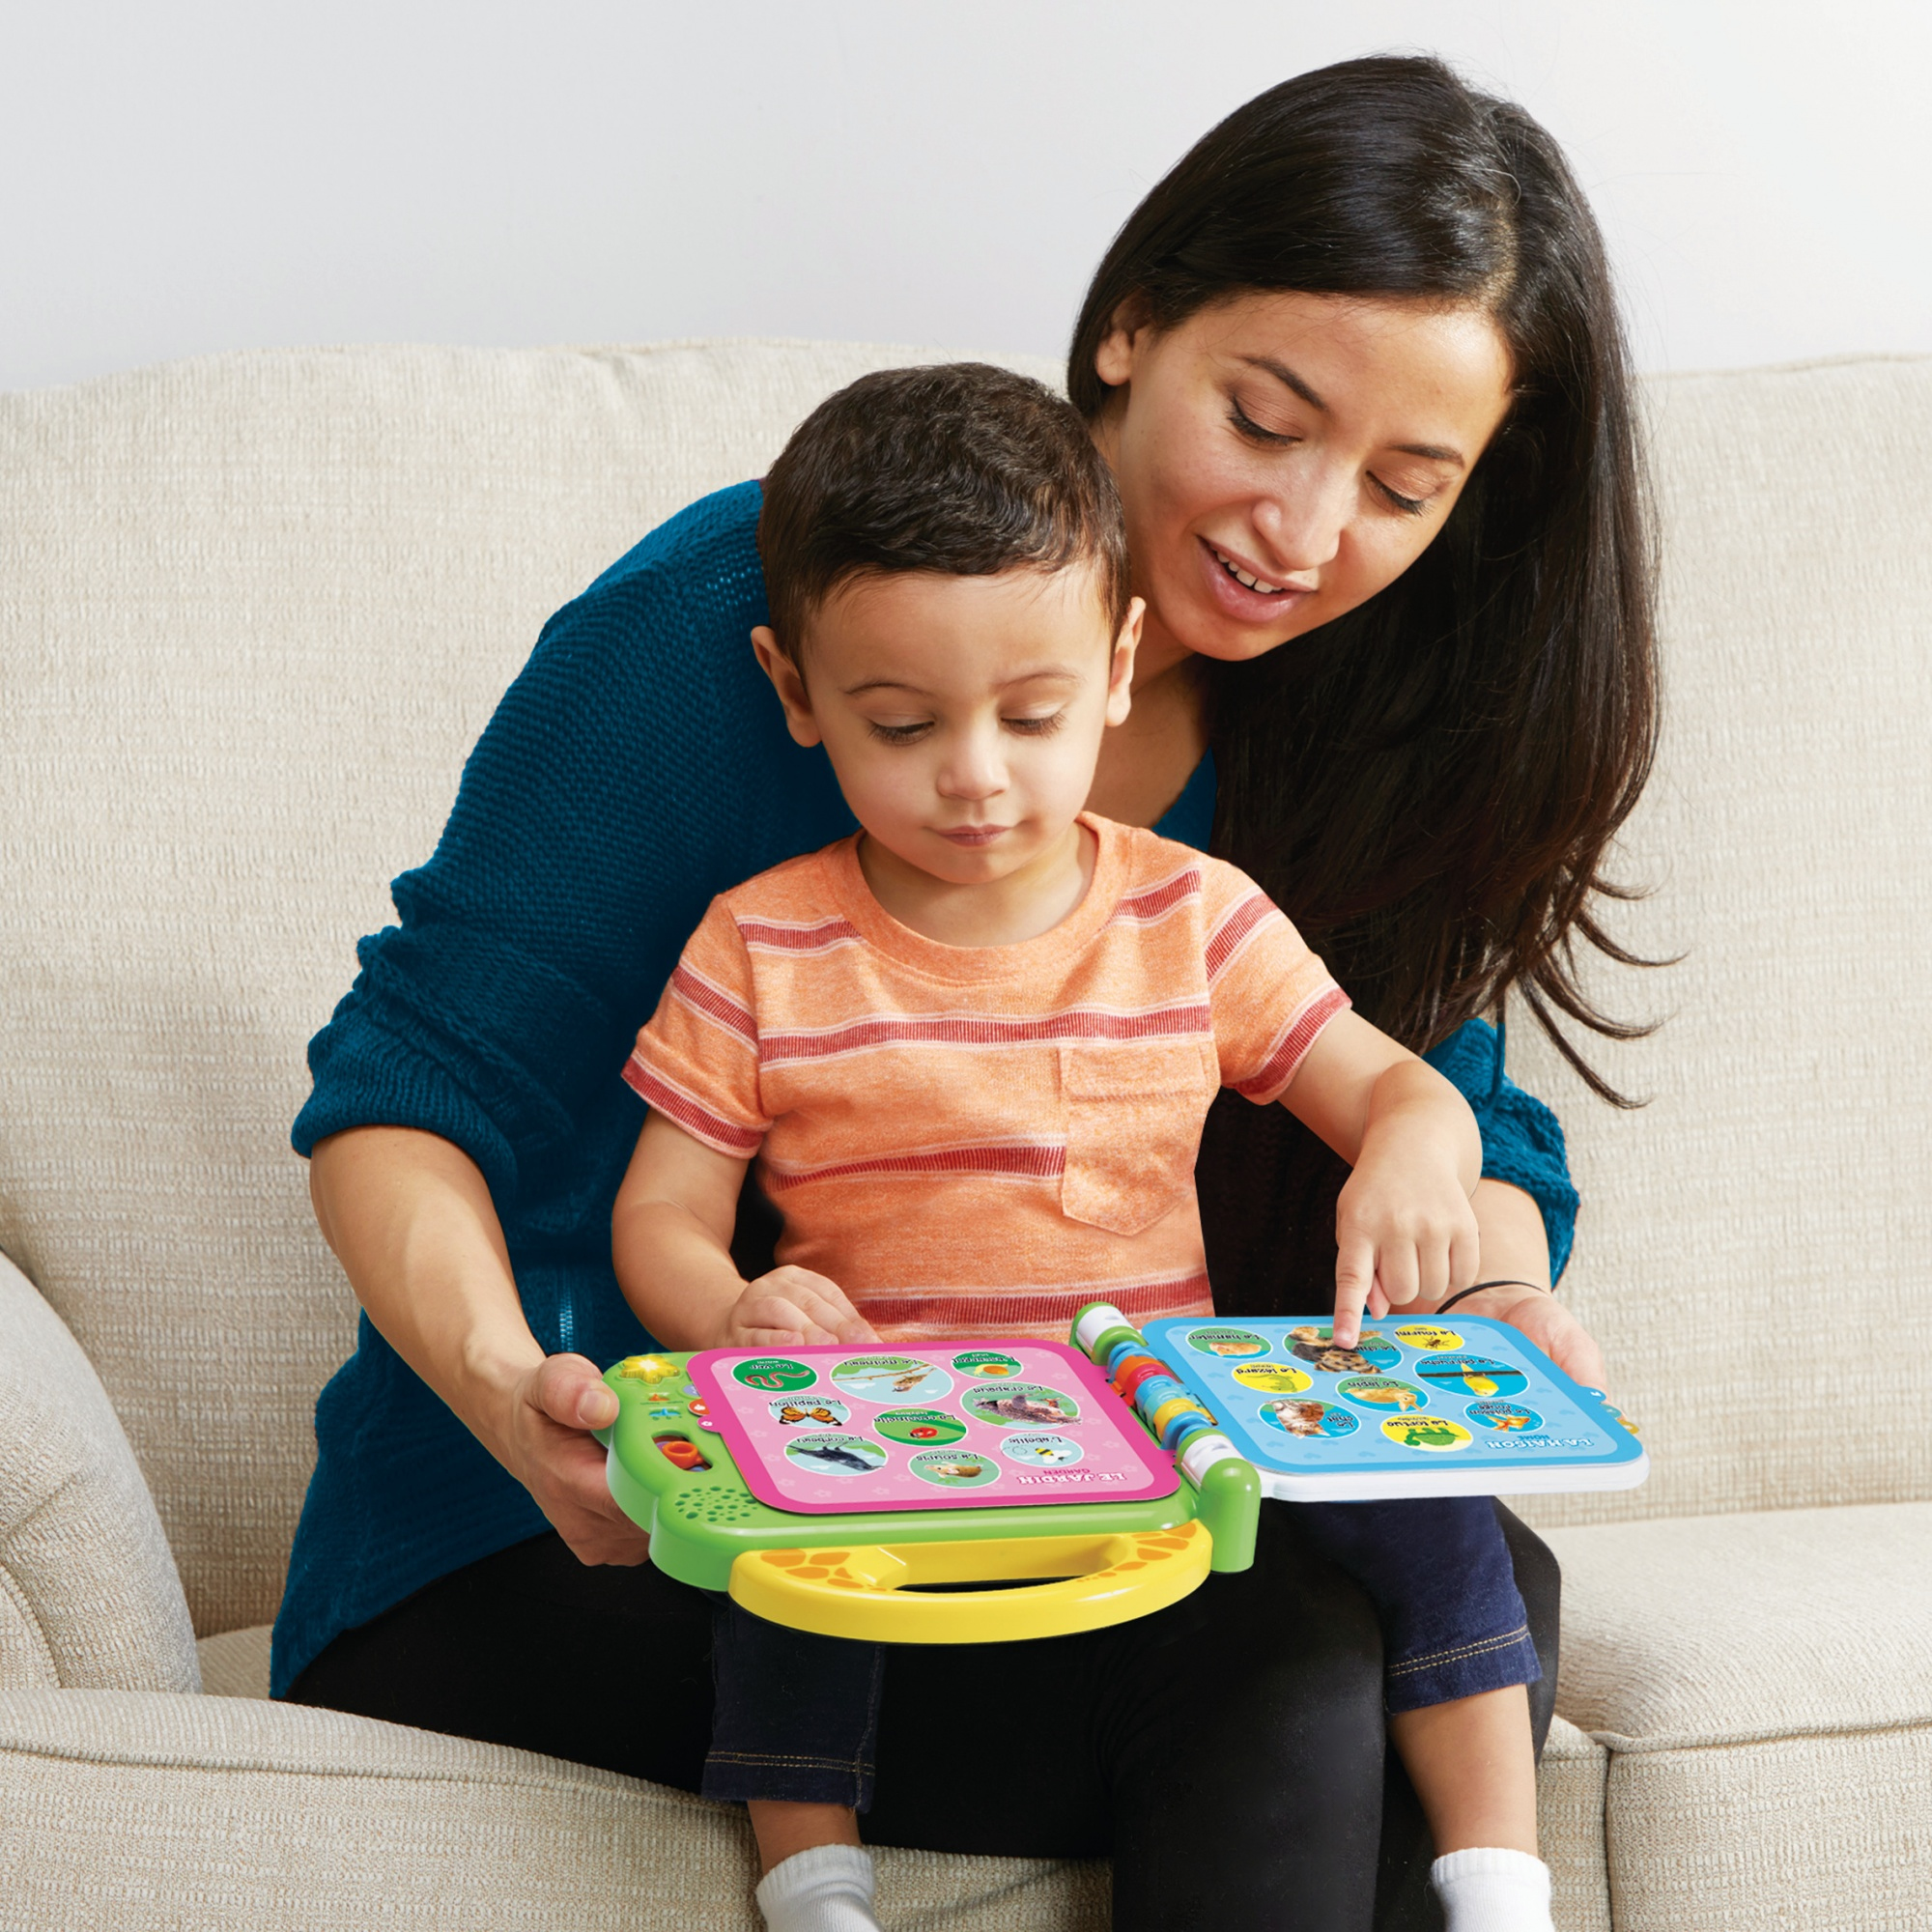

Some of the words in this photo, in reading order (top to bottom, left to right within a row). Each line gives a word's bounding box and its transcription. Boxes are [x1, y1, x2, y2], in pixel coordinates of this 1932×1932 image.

[769, 1400, 821, 1408] papillon
[1486, 1439, 1563, 1449] MAISON
[1563, 1438, 1593, 1447] LA
[1017, 1473, 1094, 1485] JARDIN
[1098, 1473, 1126, 1482] LE
